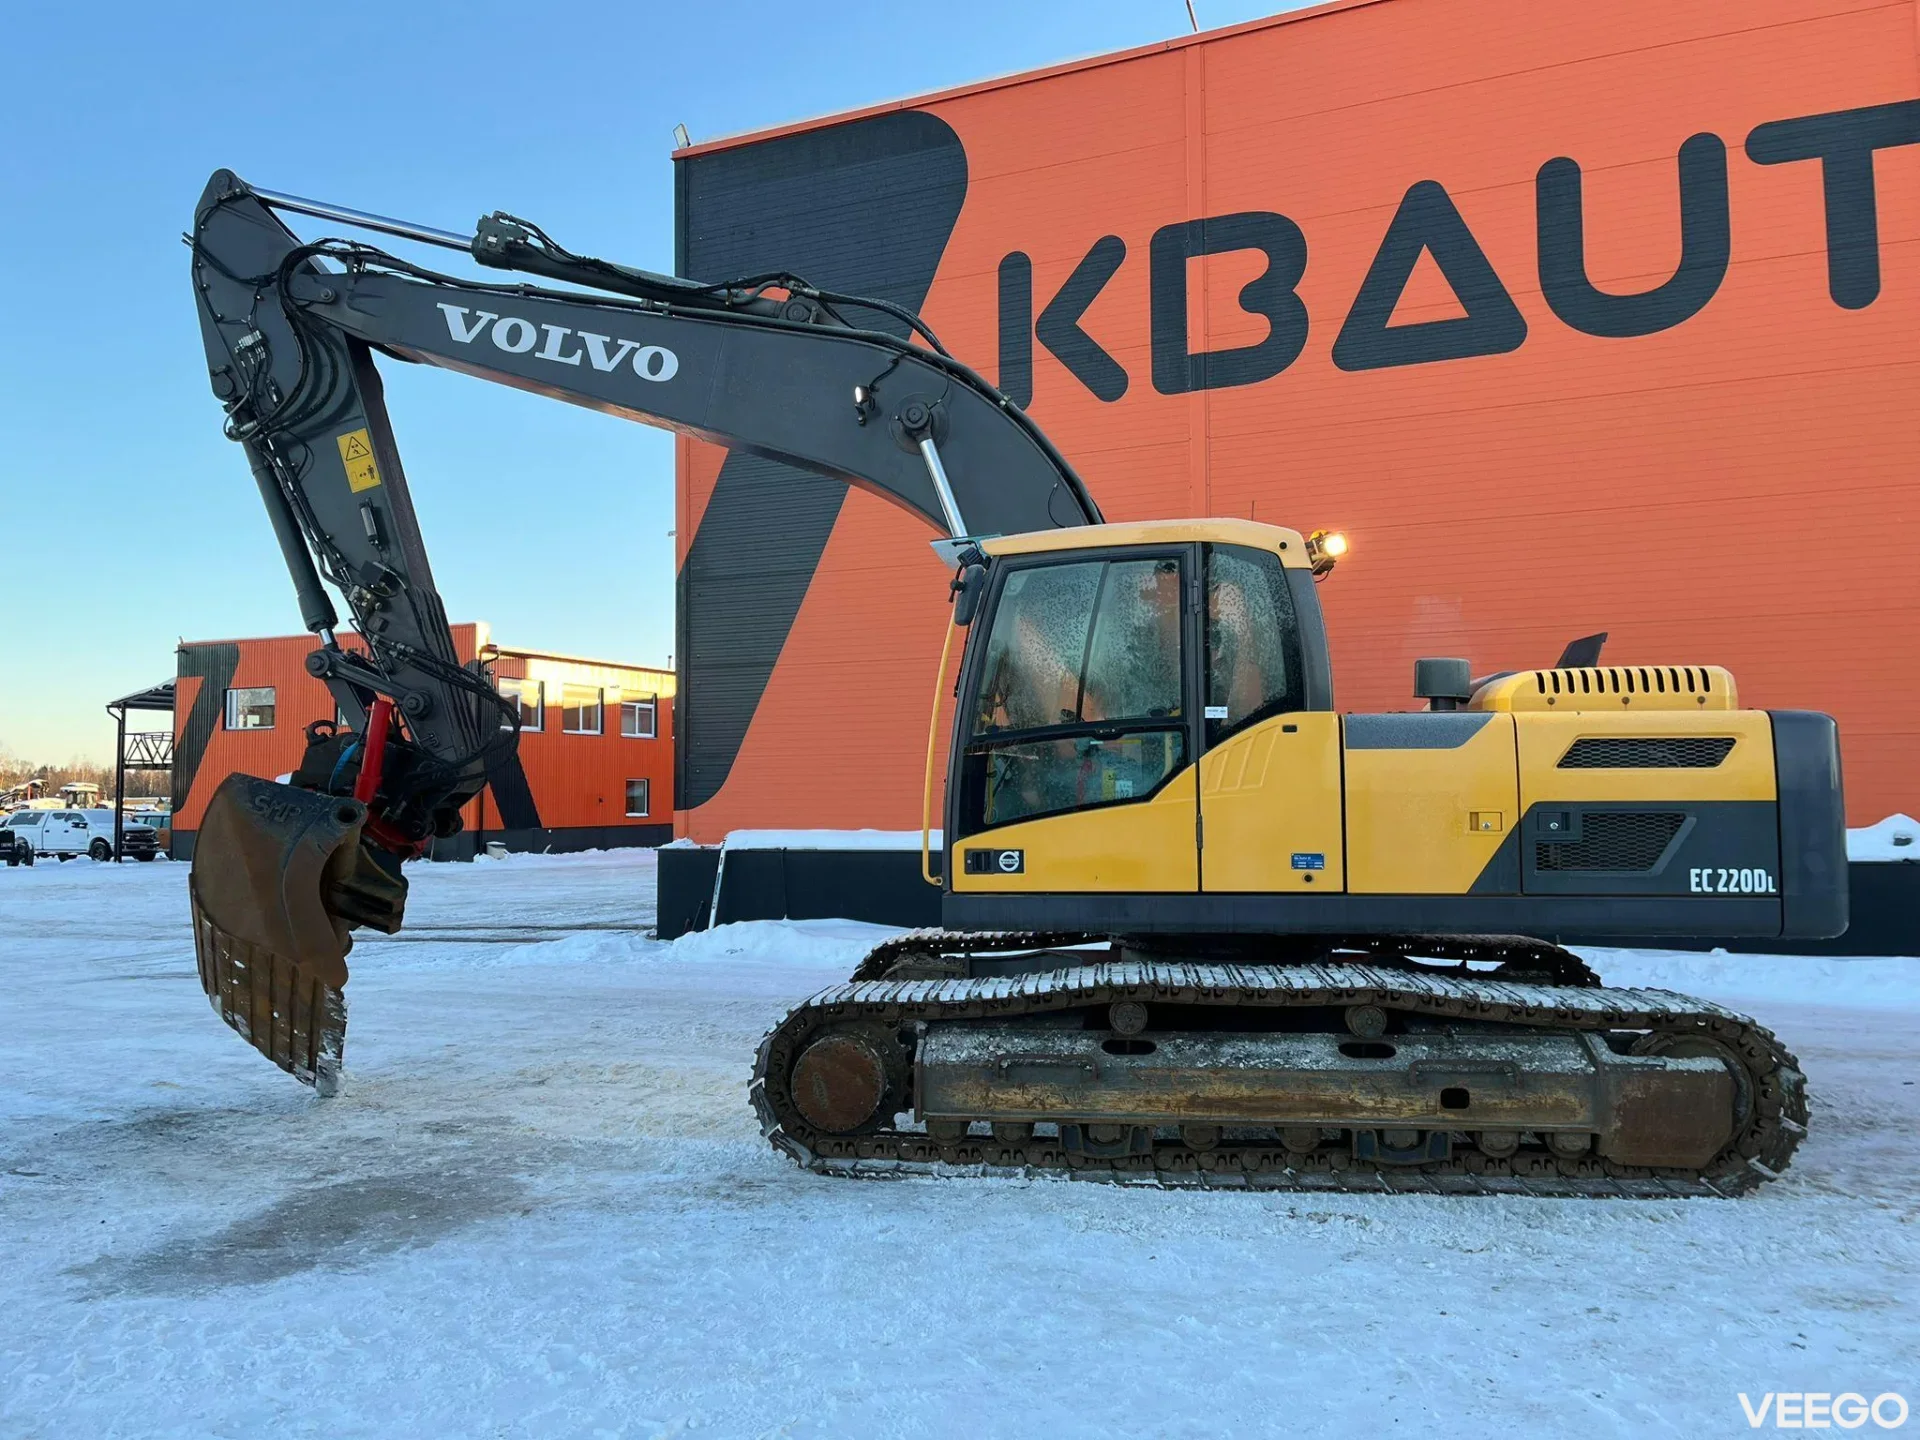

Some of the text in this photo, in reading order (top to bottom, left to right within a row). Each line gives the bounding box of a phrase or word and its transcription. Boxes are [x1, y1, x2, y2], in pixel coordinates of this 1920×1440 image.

[437, 302, 679, 382] VOLVO
[253, 793, 302, 824] SMP
[1690, 868, 1714, 893] EC
